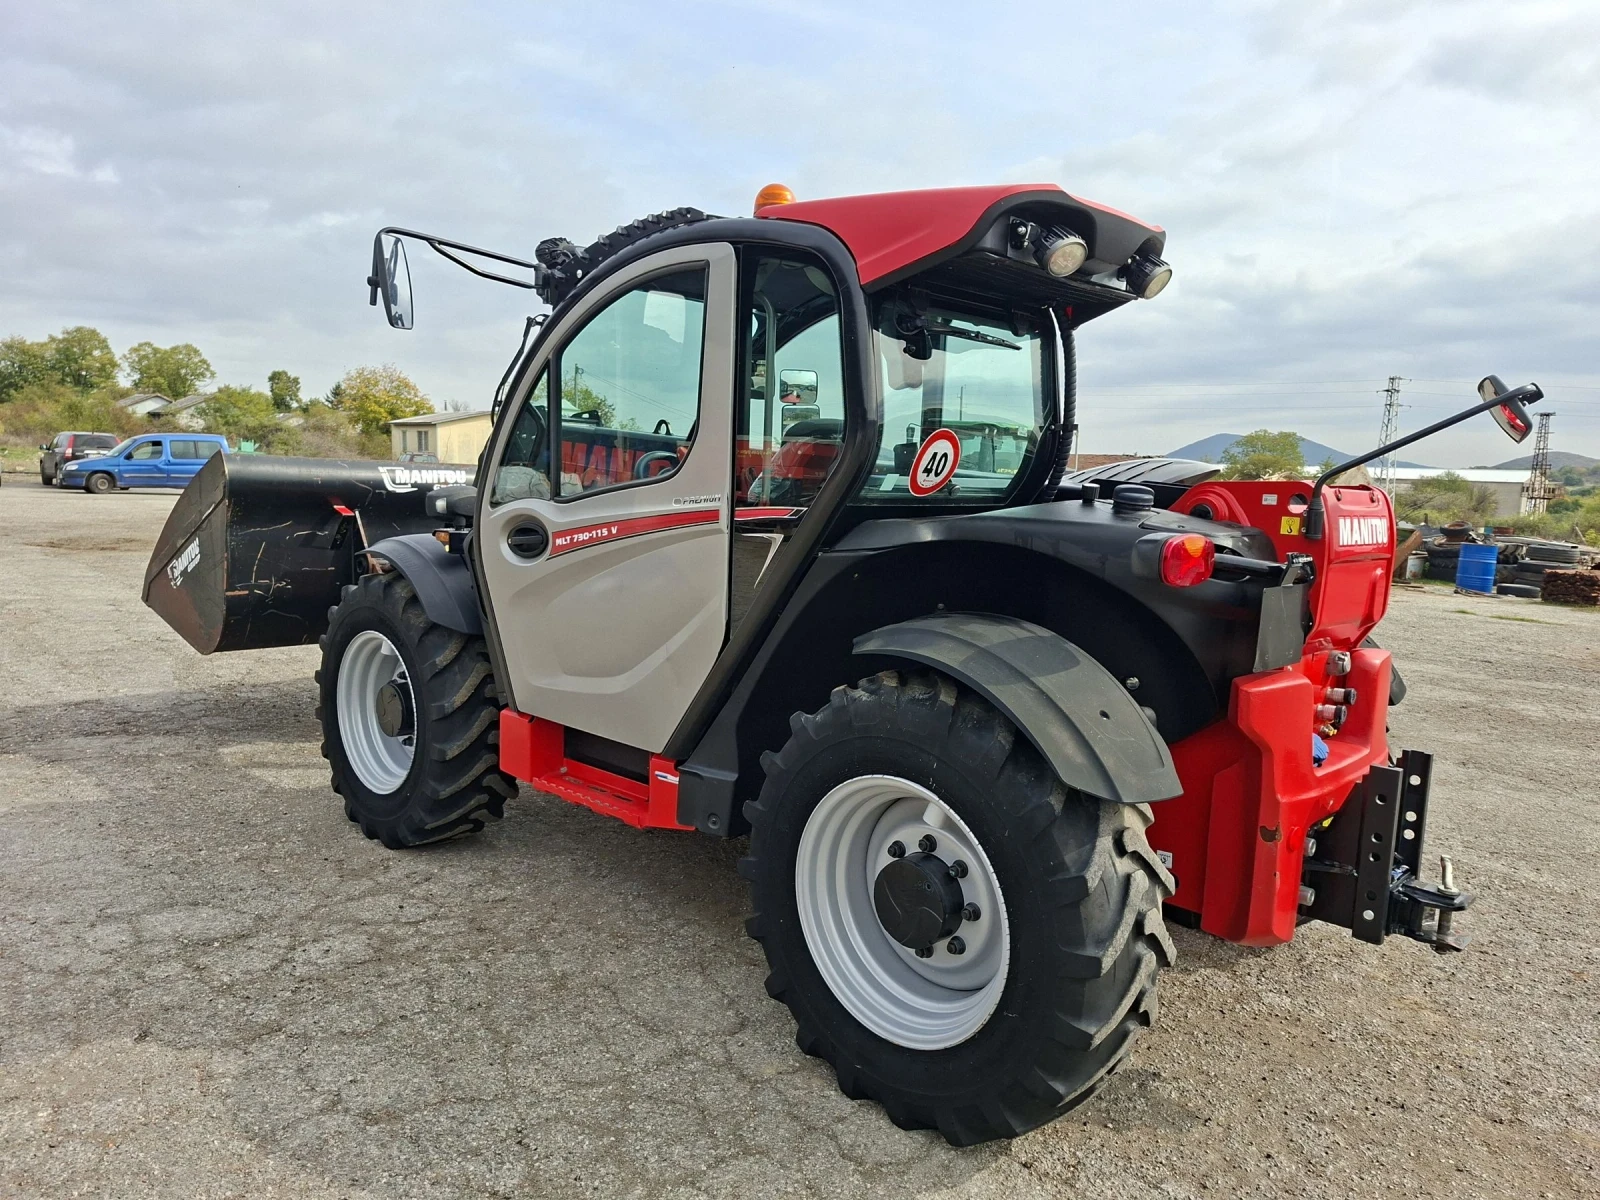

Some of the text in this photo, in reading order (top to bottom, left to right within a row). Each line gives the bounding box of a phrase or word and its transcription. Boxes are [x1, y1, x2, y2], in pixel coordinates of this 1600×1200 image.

[922, 452, 948, 478] 40
[395, 469, 467, 484] MANITOU
[682, 494, 721, 505] PREMIUM
[555, 525, 618, 546] MLT 730-115 V
[1338, 516, 1388, 546] MANITOU
